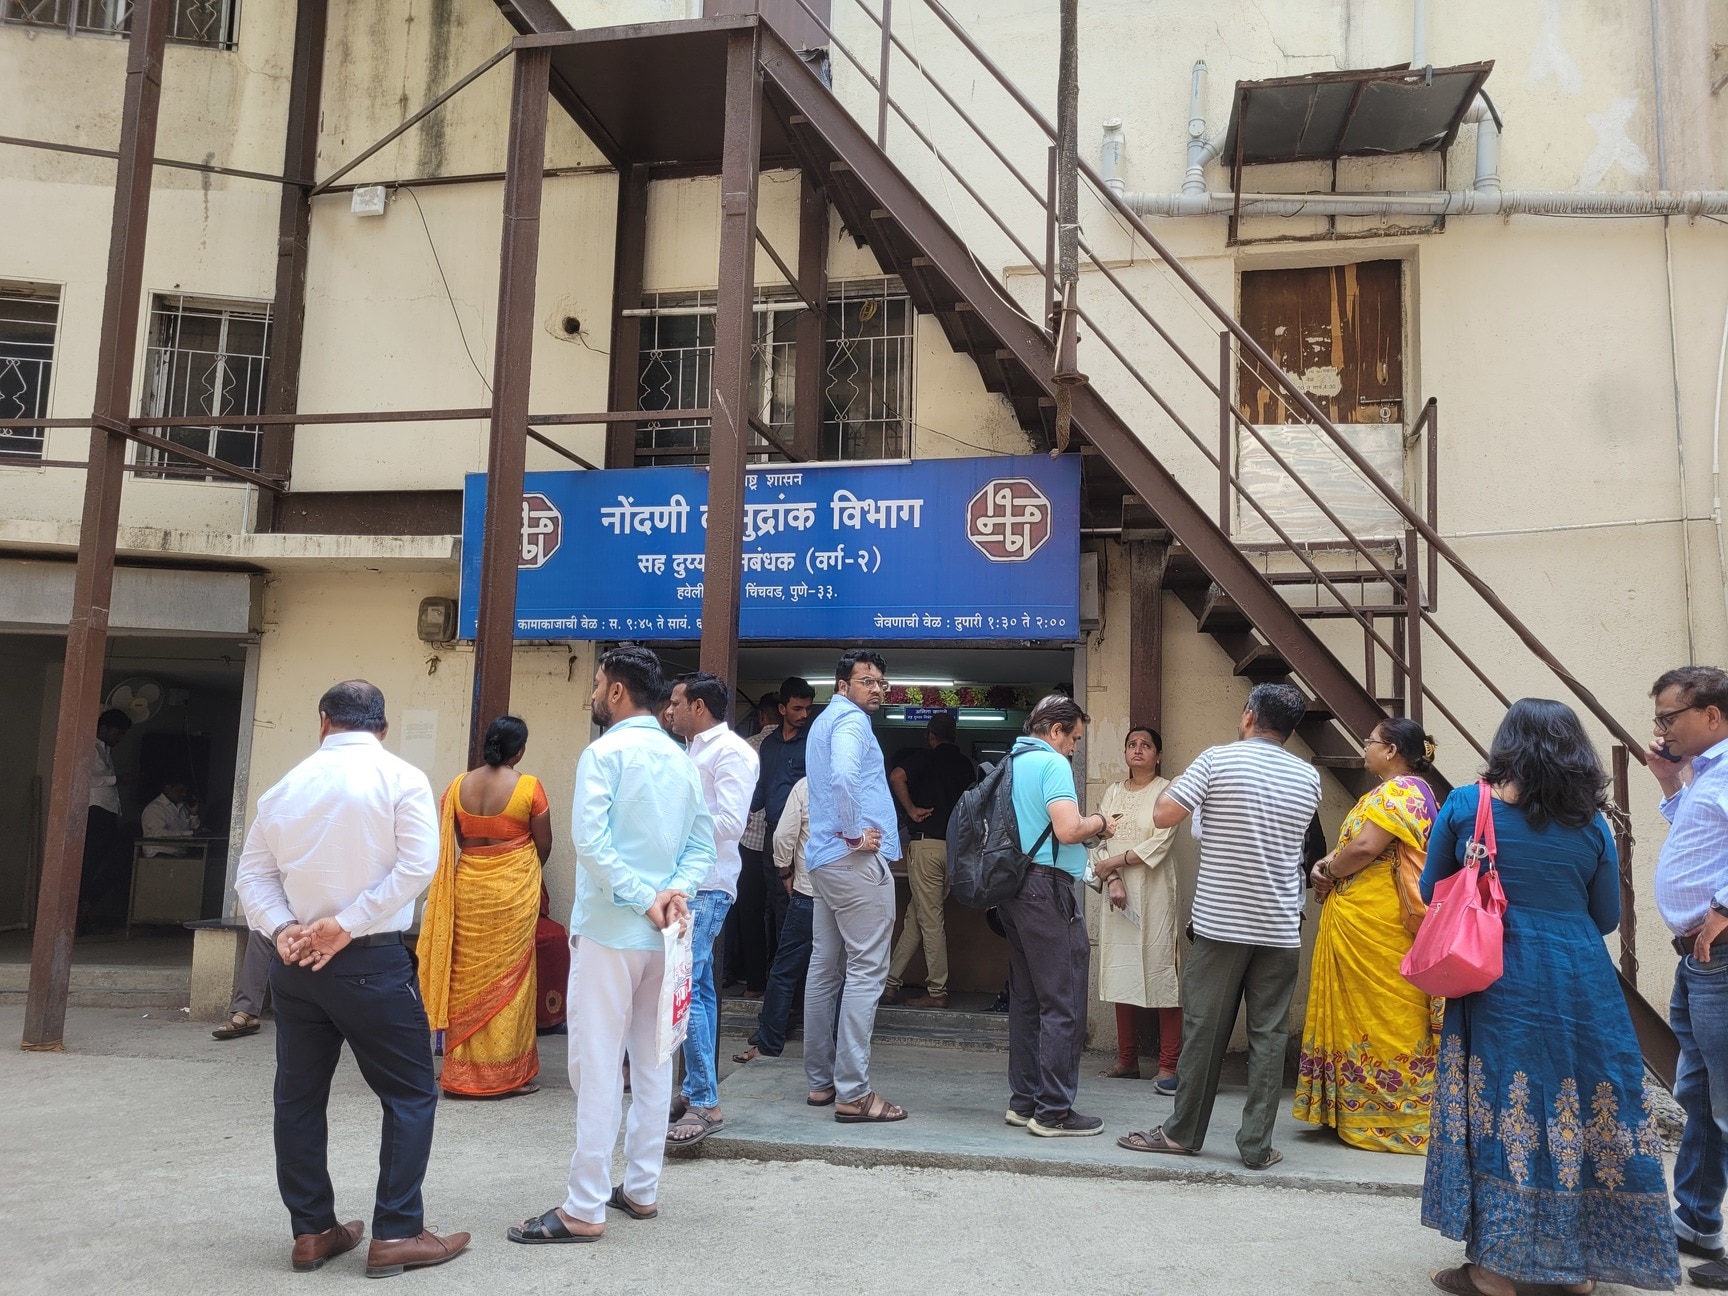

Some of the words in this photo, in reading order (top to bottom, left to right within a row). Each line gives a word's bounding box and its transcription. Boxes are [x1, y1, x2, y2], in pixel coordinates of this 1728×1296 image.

[766, 473, 803, 487] शासन
[600, 494, 690, 535] नोंदणी
[830, 489, 924, 530] विभाग
[638, 555, 666, 575] सह
[672, 554, 705, 578] दुय्य
[742, 547, 796, 572] बंधक
[806, 544, 881, 574] (वर्ग-२)
[677, 583, 704, 599] हवेली
[745, 582, 785, 600] चिंचवड,
[790, 581, 837, 602] पुणे-३३.
[517, 615, 577, 630] कामाकाजाची
[580, 615, 598, 629] वेळ
[608, 618, 621, 629] स.
[626, 618, 653, 630] ९:४५
[656, 614, 664, 630] ते
[667, 614, 691, 630] सायं.
[874, 613, 919, 628] जेवणाची
[922, 612, 942, 628] वेळ
[954, 613, 982, 631] दुपारी
[988, 616, 1017, 629] १:३०
[1021, 612, 1030, 628] ते
[1036, 616, 1066, 629] २:००
